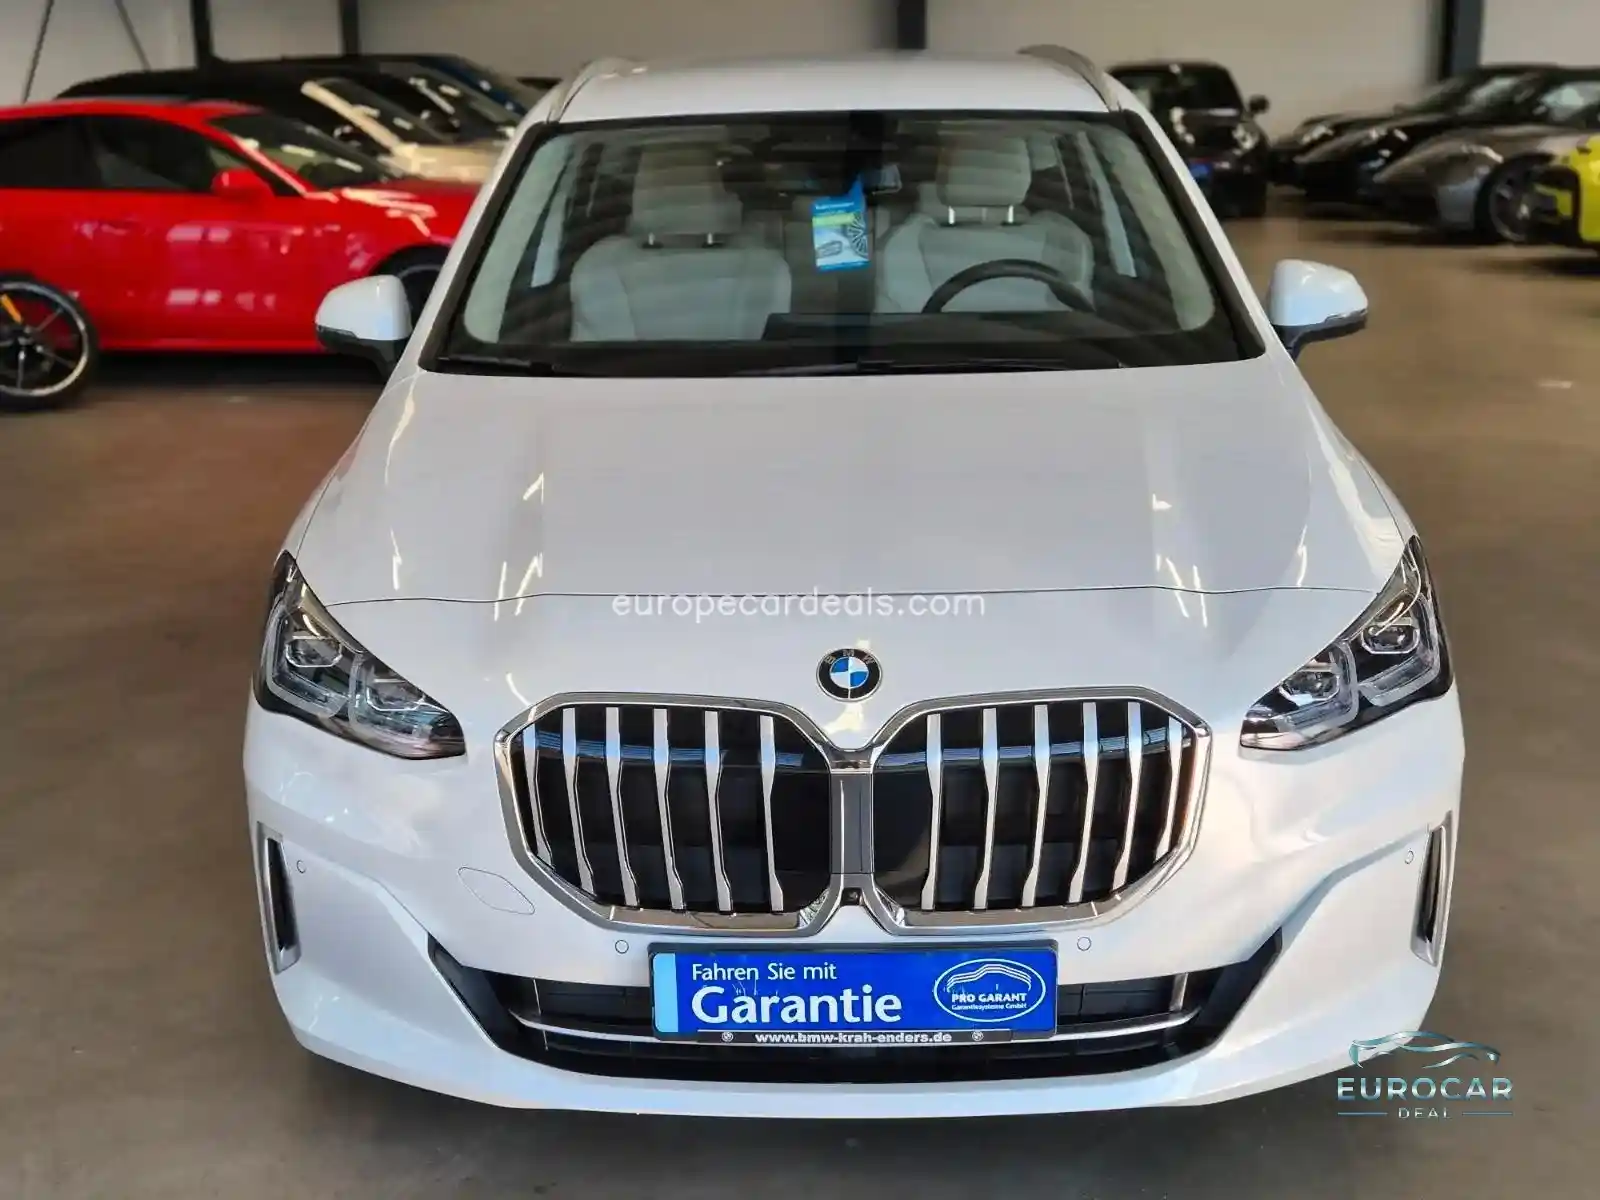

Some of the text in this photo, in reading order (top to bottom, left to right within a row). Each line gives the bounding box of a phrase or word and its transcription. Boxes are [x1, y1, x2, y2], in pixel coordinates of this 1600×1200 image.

[691, 961, 837, 981] Fahren Sie mit
[691, 984, 903, 1024] Garantie
[951, 992, 1028, 1003] PRO GARANT
[754, 1031, 953, 1044] www.bmw-krah-enders.de
